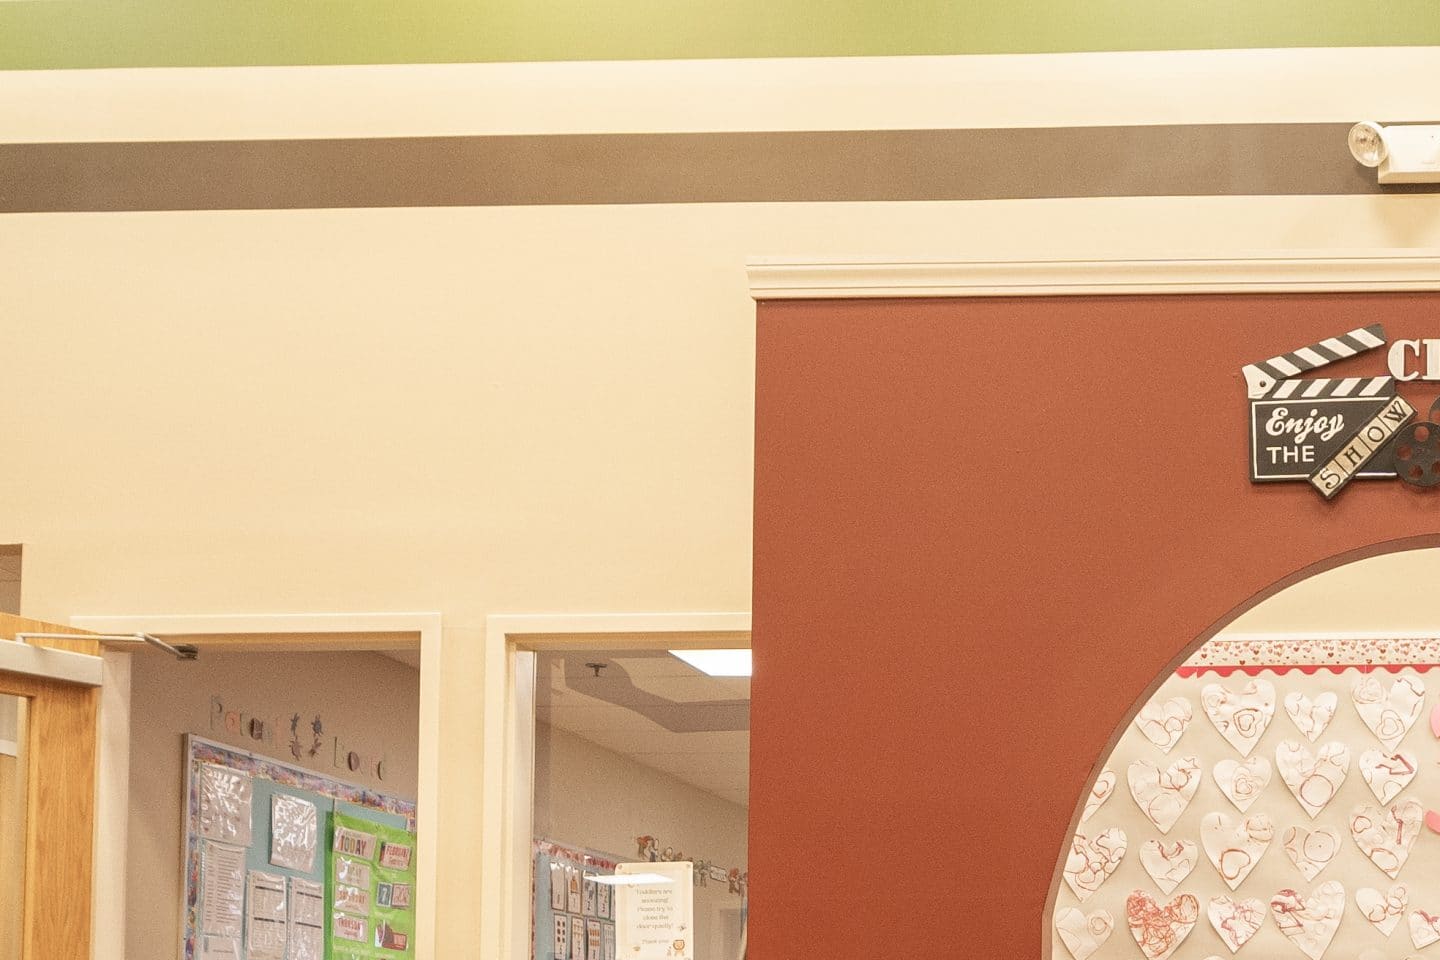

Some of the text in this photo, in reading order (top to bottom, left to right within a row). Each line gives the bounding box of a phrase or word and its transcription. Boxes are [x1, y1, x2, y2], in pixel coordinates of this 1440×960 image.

[1265, 406, 1345, 444] Enjoy
[1265, 445, 1316, 465] THE
[1319, 400, 1408, 490] SHOW
[340, 835, 368, 857] TODAY
